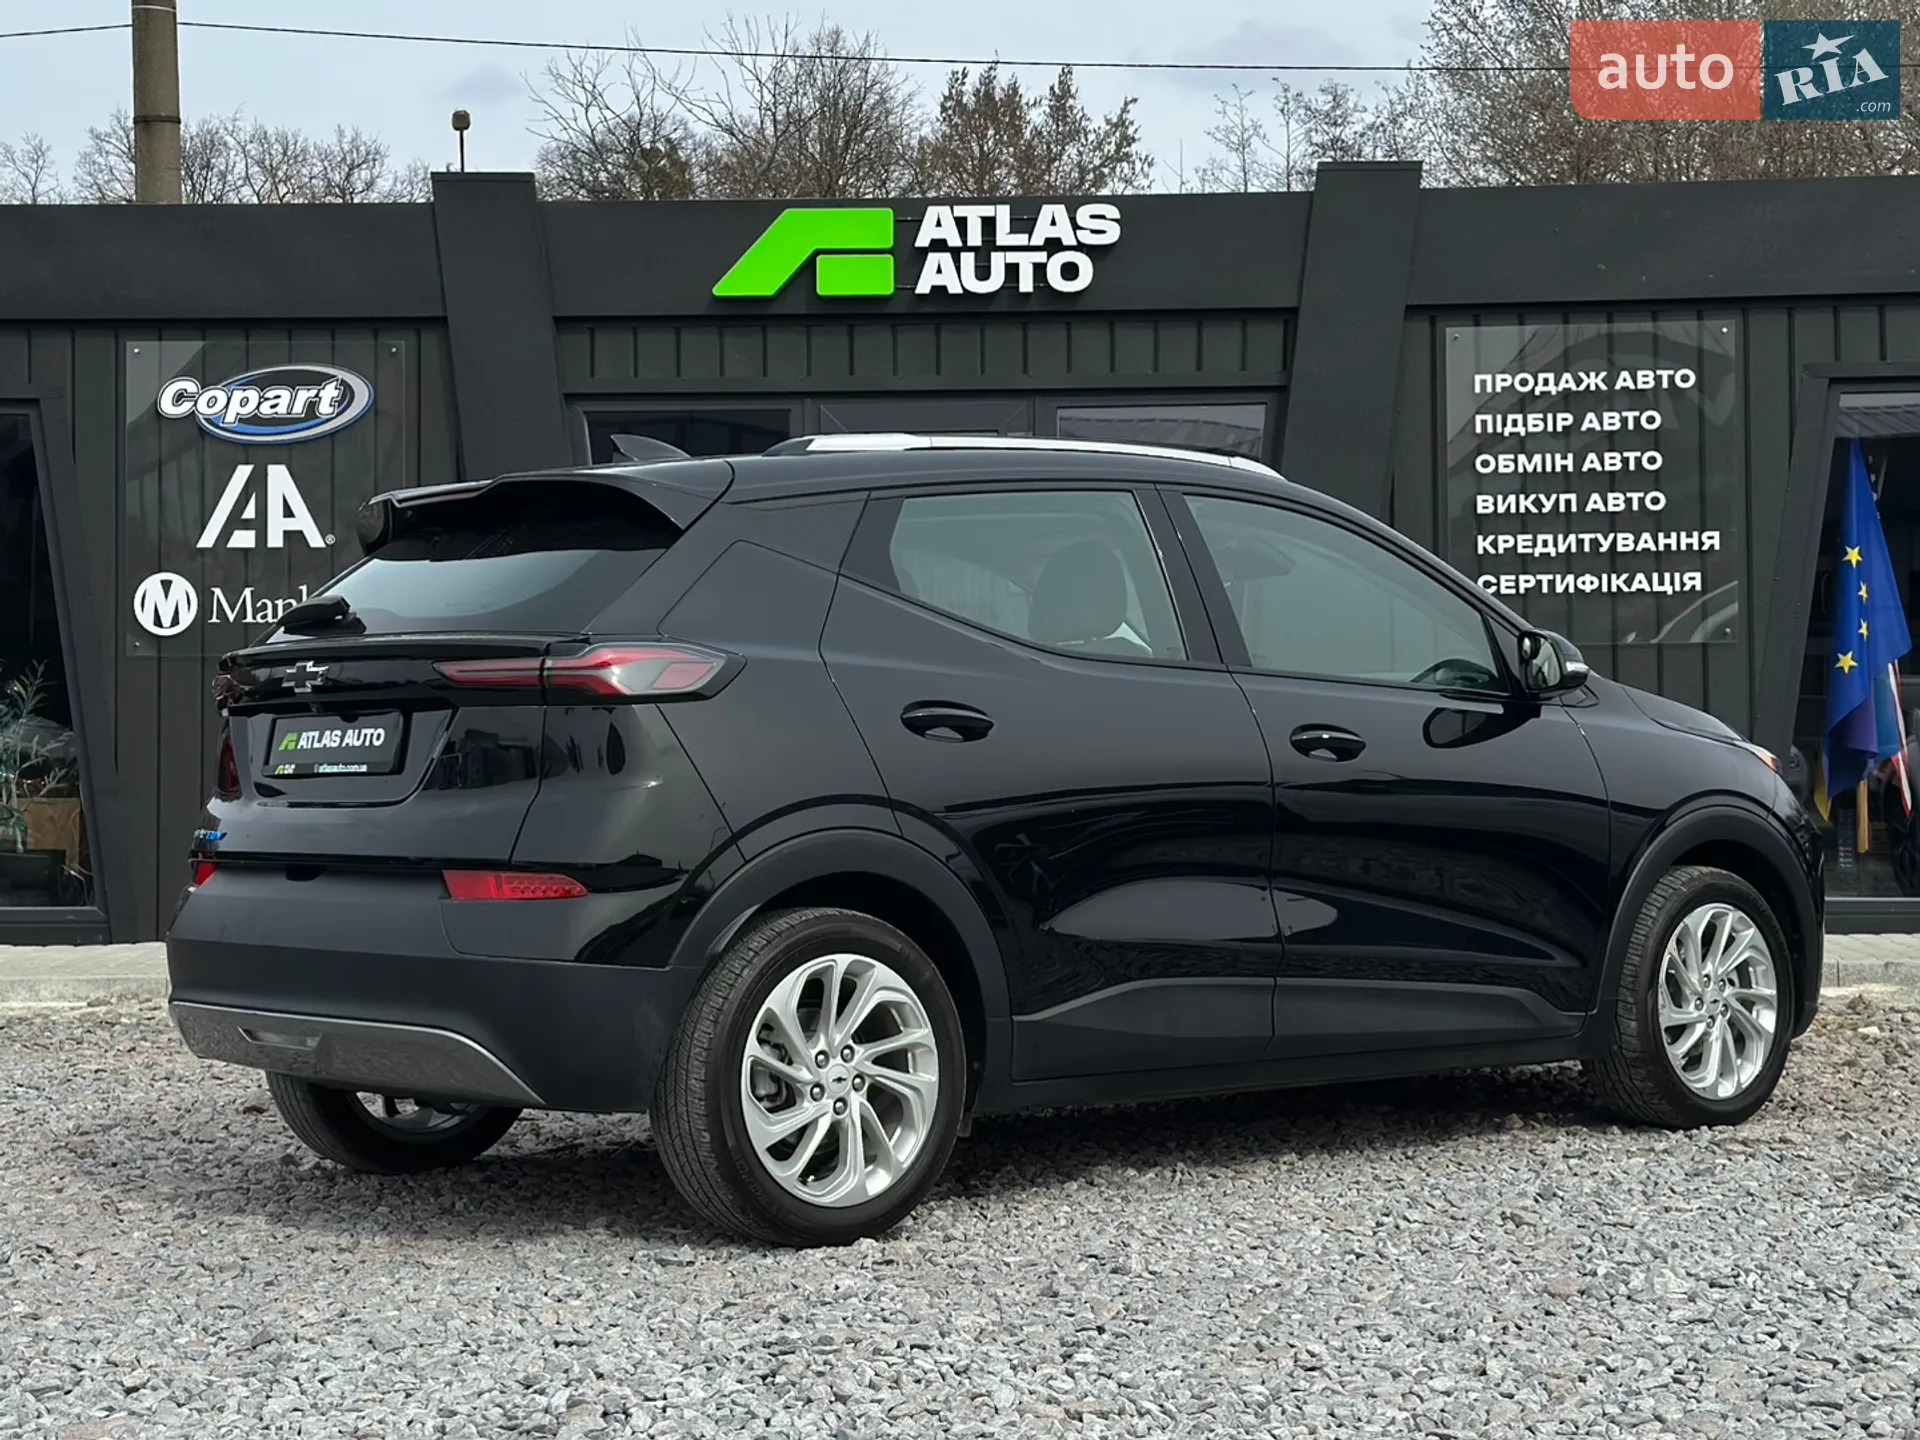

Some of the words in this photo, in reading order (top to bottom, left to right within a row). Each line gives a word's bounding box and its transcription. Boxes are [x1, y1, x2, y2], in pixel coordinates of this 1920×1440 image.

[914, 203, 1122, 247] ATLAS
[914, 250, 1095, 294] AUTO
[1474, 371, 1608, 396] ПРОДАЖ
[1614, 368, 1697, 391] АВТО
[157, 376, 344, 427] Copart
[1474, 412, 1574, 437] ПІДБІР
[1580, 410, 1663, 432] АВТО
[1474, 453, 1575, 474] ОБМІН
[1581, 450, 1664, 473] АВТО
[1476, 493, 1578, 515] ВИКУП
[1584, 491, 1668, 513] АВТО
[1477, 531, 1721, 558] КРЕДИТУВАННЯ
[1477, 571, 1703, 595] СЕРТИФІКАЦІЯ
[297, 729, 343, 750] ATLAS
[342, 727, 387, 748] AUTO
